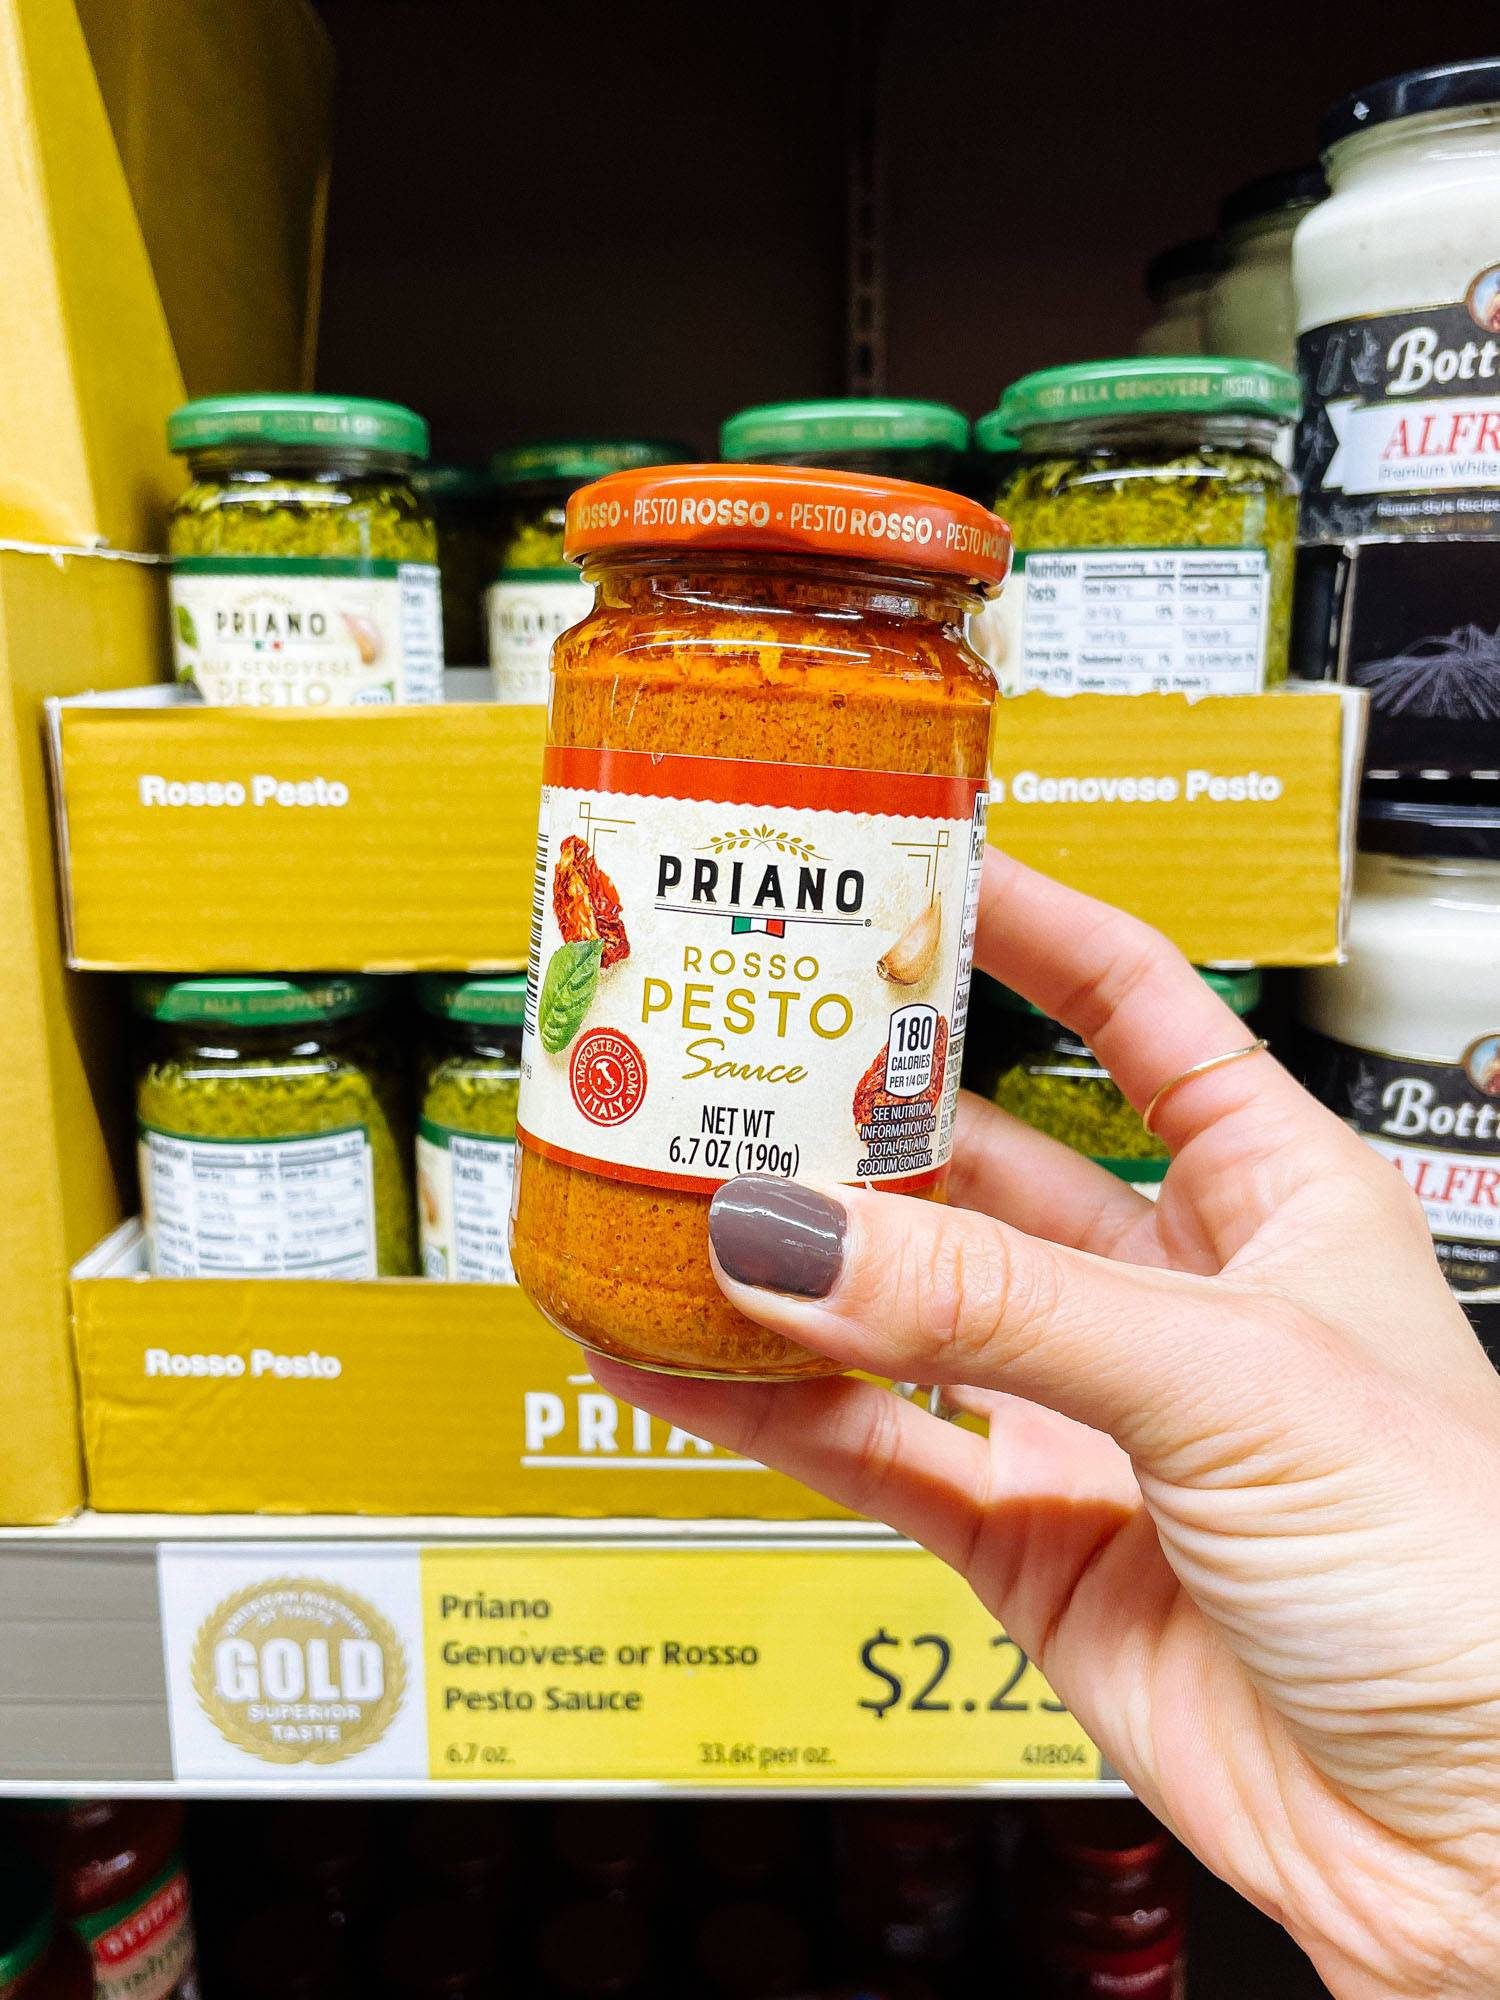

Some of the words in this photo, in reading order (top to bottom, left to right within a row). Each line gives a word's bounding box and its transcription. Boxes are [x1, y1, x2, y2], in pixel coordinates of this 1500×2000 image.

[633, 498, 677, 526] PESTO
[680, 498, 770, 528] ROSSO
[790, 502, 847, 534] PESTO
[850, 508, 933, 545] ROSSO
[945, 522, 981, 556] PESTO
[213, 610, 327, 637] PRIANO
[217, 678, 332, 706] PESTO
[140, 775, 246, 807] Rosso
[251, 775, 349, 807] Pesto
[1012, 771, 1179, 803] Genovese
[1185, 770, 1282, 802] Pesto
[655, 854, 865, 914] PRIANO
[683, 945, 820, 982] ROSSO
[641, 976, 854, 1040] PESTO
[896, 1016, 933, 1052] 180
[577, 1039, 622, 1083] IMPORTED
[621, 1052, 639, 1096] FROM
[682, 1037, 809, 1084] Sauce
[890, 1054, 931, 1072] CALORIES
[889, 1075, 905, 1089] PER
[905, 1074, 916, 1088] 1/4
[916, 1072, 930, 1086] CUP
[583, 1093, 626, 1118] ITALY
[872, 1107, 890, 1121] SEE
[890, 1101, 932, 1120] NUTRITION
[1381, 1077, 1500, 1138] Bott
[701, 1104, 739, 1136] NET
[743, 1108, 775, 1138] WT
[861, 1120, 922, 1140] INFORMATION
[922, 1117, 936, 1133] FOR
[668, 1135, 700, 1165] 6.7
[705, 1138, 731, 1168] OZ
[736, 1140, 800, 1178] (190g)
[868, 1141, 898, 1157] TOTAL
[898, 1138, 913, 1153] FAT
[912, 1135, 929, 1151] AND
[858, 1159, 898, 1175] SODIUM
[1393, 1156, 1500, 1208] LFR
[144, 1349, 246, 1378] Rosso
[251, 1349, 342, 1379] Pesto
[441, 1591, 551, 1620] Priano
[442, 1639, 607, 1666] Genovese
[616, 1643, 650, 1666] or
[662, 1640, 759, 1667] Rosso
[214, 1637, 385, 1701] GOLD
[857, 1626, 1070, 1720] $2.2
[249, 1703, 362, 1722] SUPERIOR
[444, 1686, 535, 1713] Pesto
[545, 1686, 642, 1713] Sauce
[271, 1724, 341, 1741] TASTE
[446, 1742, 478, 1763] 6.7
[759, 1747, 799, 1769] per
